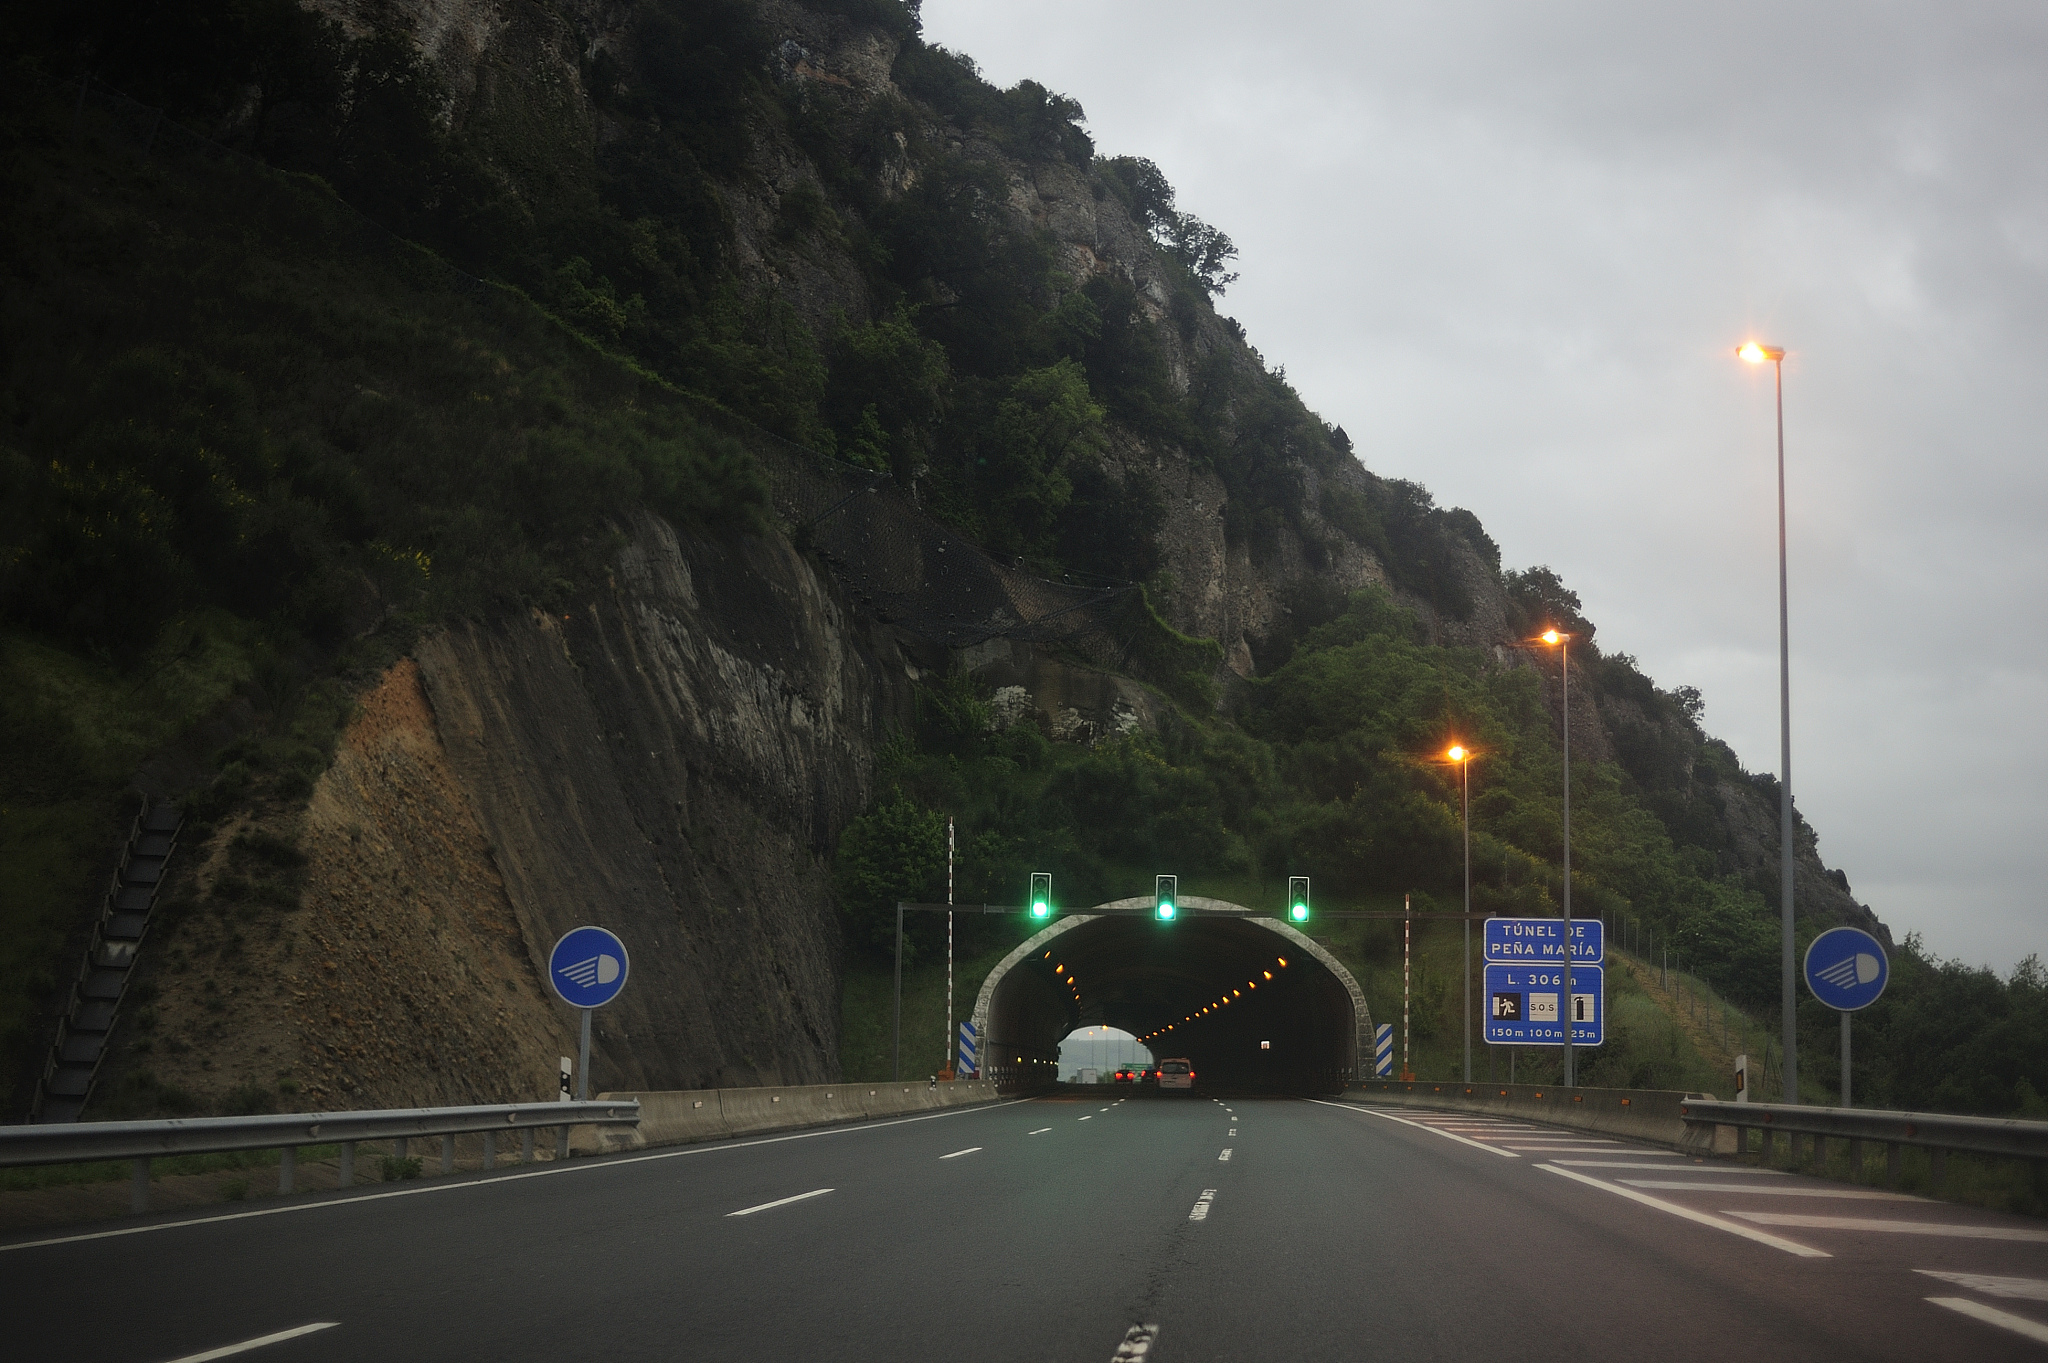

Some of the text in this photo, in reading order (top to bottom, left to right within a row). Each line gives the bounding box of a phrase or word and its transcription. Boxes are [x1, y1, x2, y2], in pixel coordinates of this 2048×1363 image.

[1503, 923, 1556, 936] TÚNEL
[1492, 942, 1595, 955] PEÑA MARÍA
[1507, 974, 1520, 985] L.
[1528, 975, 1561, 985] 306
